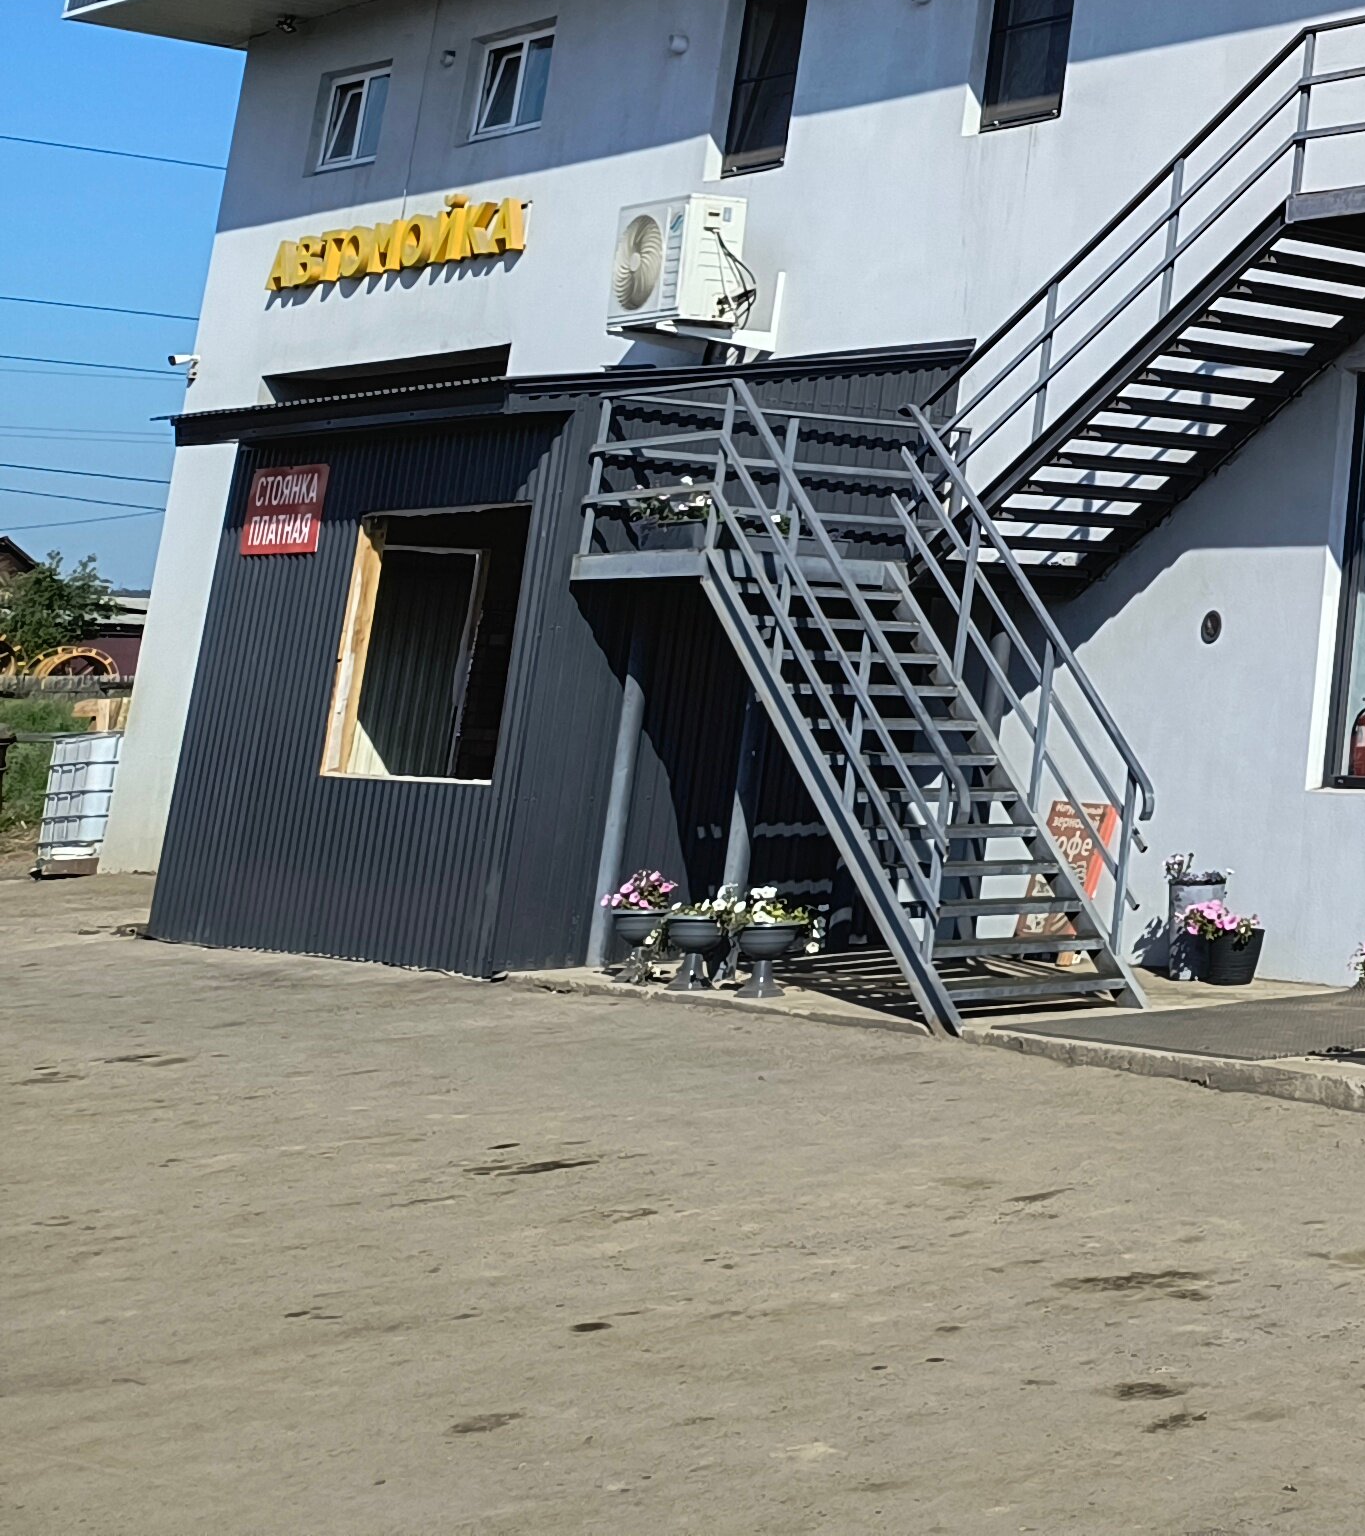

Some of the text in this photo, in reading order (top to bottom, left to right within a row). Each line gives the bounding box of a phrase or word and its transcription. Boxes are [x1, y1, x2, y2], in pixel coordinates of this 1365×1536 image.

[265, 194, 526, 292] АВТОМОЙКА
[256, 473, 318, 506] СТОЯНКА
[248, 513, 312, 545] ПЛАТНАЯ
